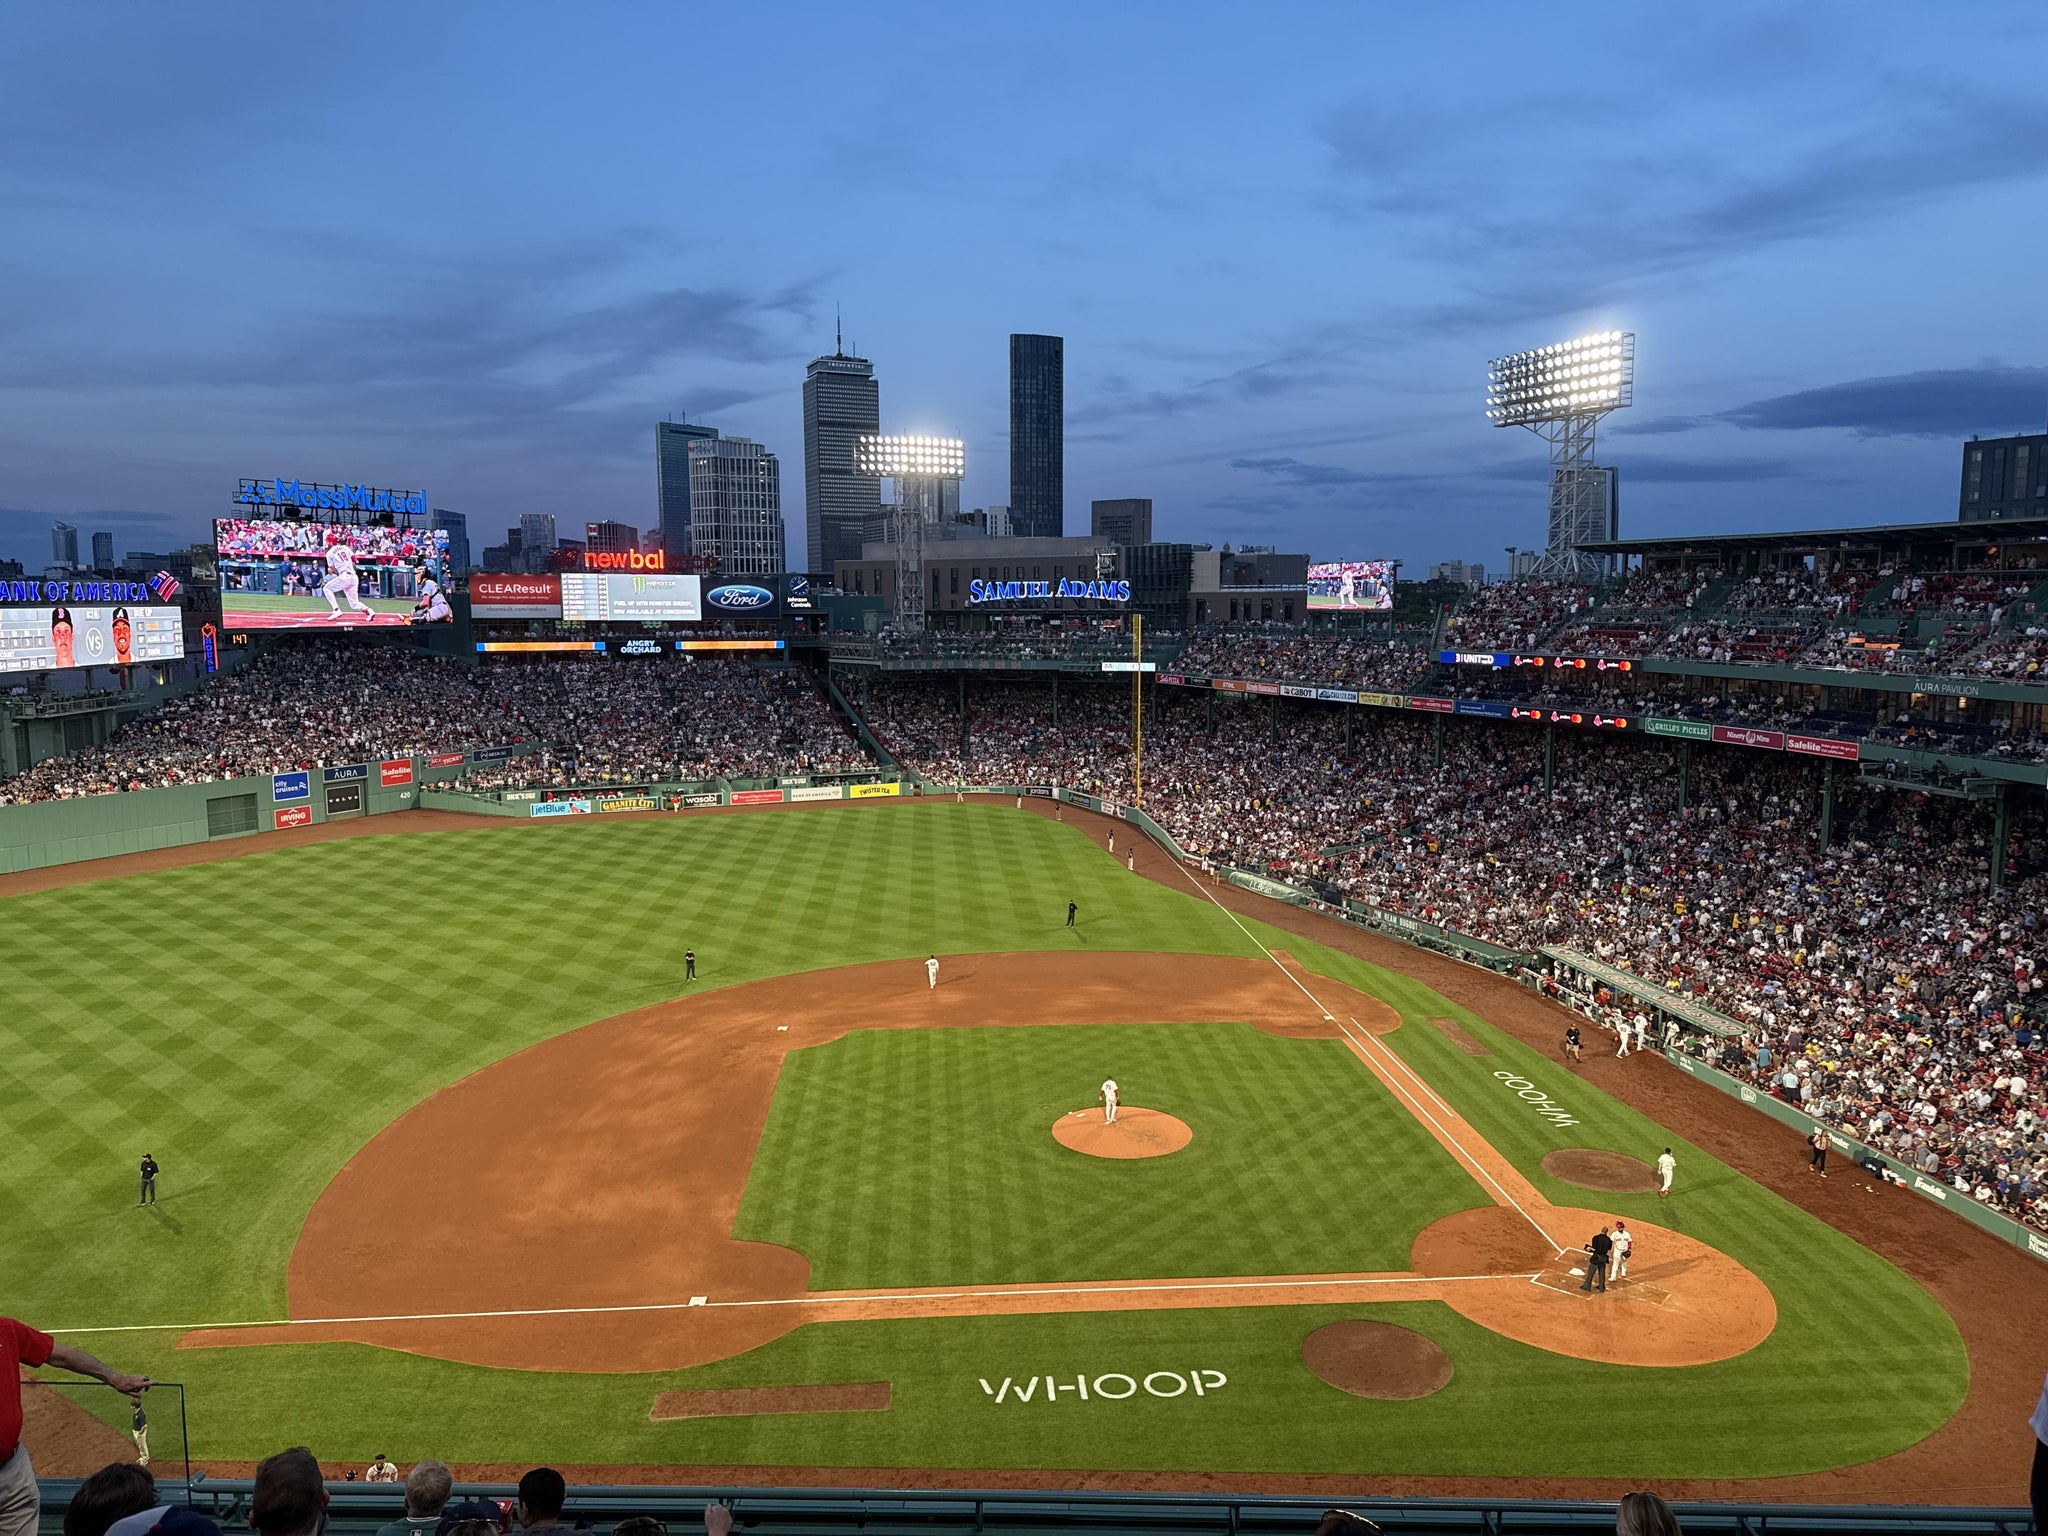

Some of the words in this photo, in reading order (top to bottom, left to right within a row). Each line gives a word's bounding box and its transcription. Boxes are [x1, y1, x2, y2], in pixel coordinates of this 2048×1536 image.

[275, 477, 427, 515] MassMutual
[584, 552, 627, 567] new
[46, 581, 69, 602] OF
[74, 581, 150, 602] AMERICA
[478, 583, 551, 594] CLEAResult
[969, 578, 1054, 604] SAMUEL
[1055, 576, 1131, 602] ADAMS
[720, 588, 760, 605] Ford
[88, 635, 100, 651] VS
[620, 646, 662, 654] ORCHARD
[1941, 684, 1979, 696] PAVILION
[1655, 722, 1681, 733] GRILLO'S
[1682, 725, 1709, 736] PICKLES
[1727, 730, 1746, 740] Ninety
[1756, 734, 1770, 743] Nine
[1788, 739, 1821, 751] Safelite
[382, 767, 411, 777] Safelite
[275, 780, 288, 788] city
[275, 785, 299, 794] cruises
[400, 791, 411, 799] 420
[859, 787, 880, 796] TWISTED
[329, 795, 359, 803] VOLVO
[602, 799, 637, 811] GRANITE
[638, 798, 655, 808] CITY
[686, 795, 717, 804] wasabi
[534, 803, 566, 815] jetBlue
[280, 812, 306, 822] IRVING
[1493, 1071, 1580, 1128] WHOOP
[978, 1370, 1228, 1404] WHOOP
